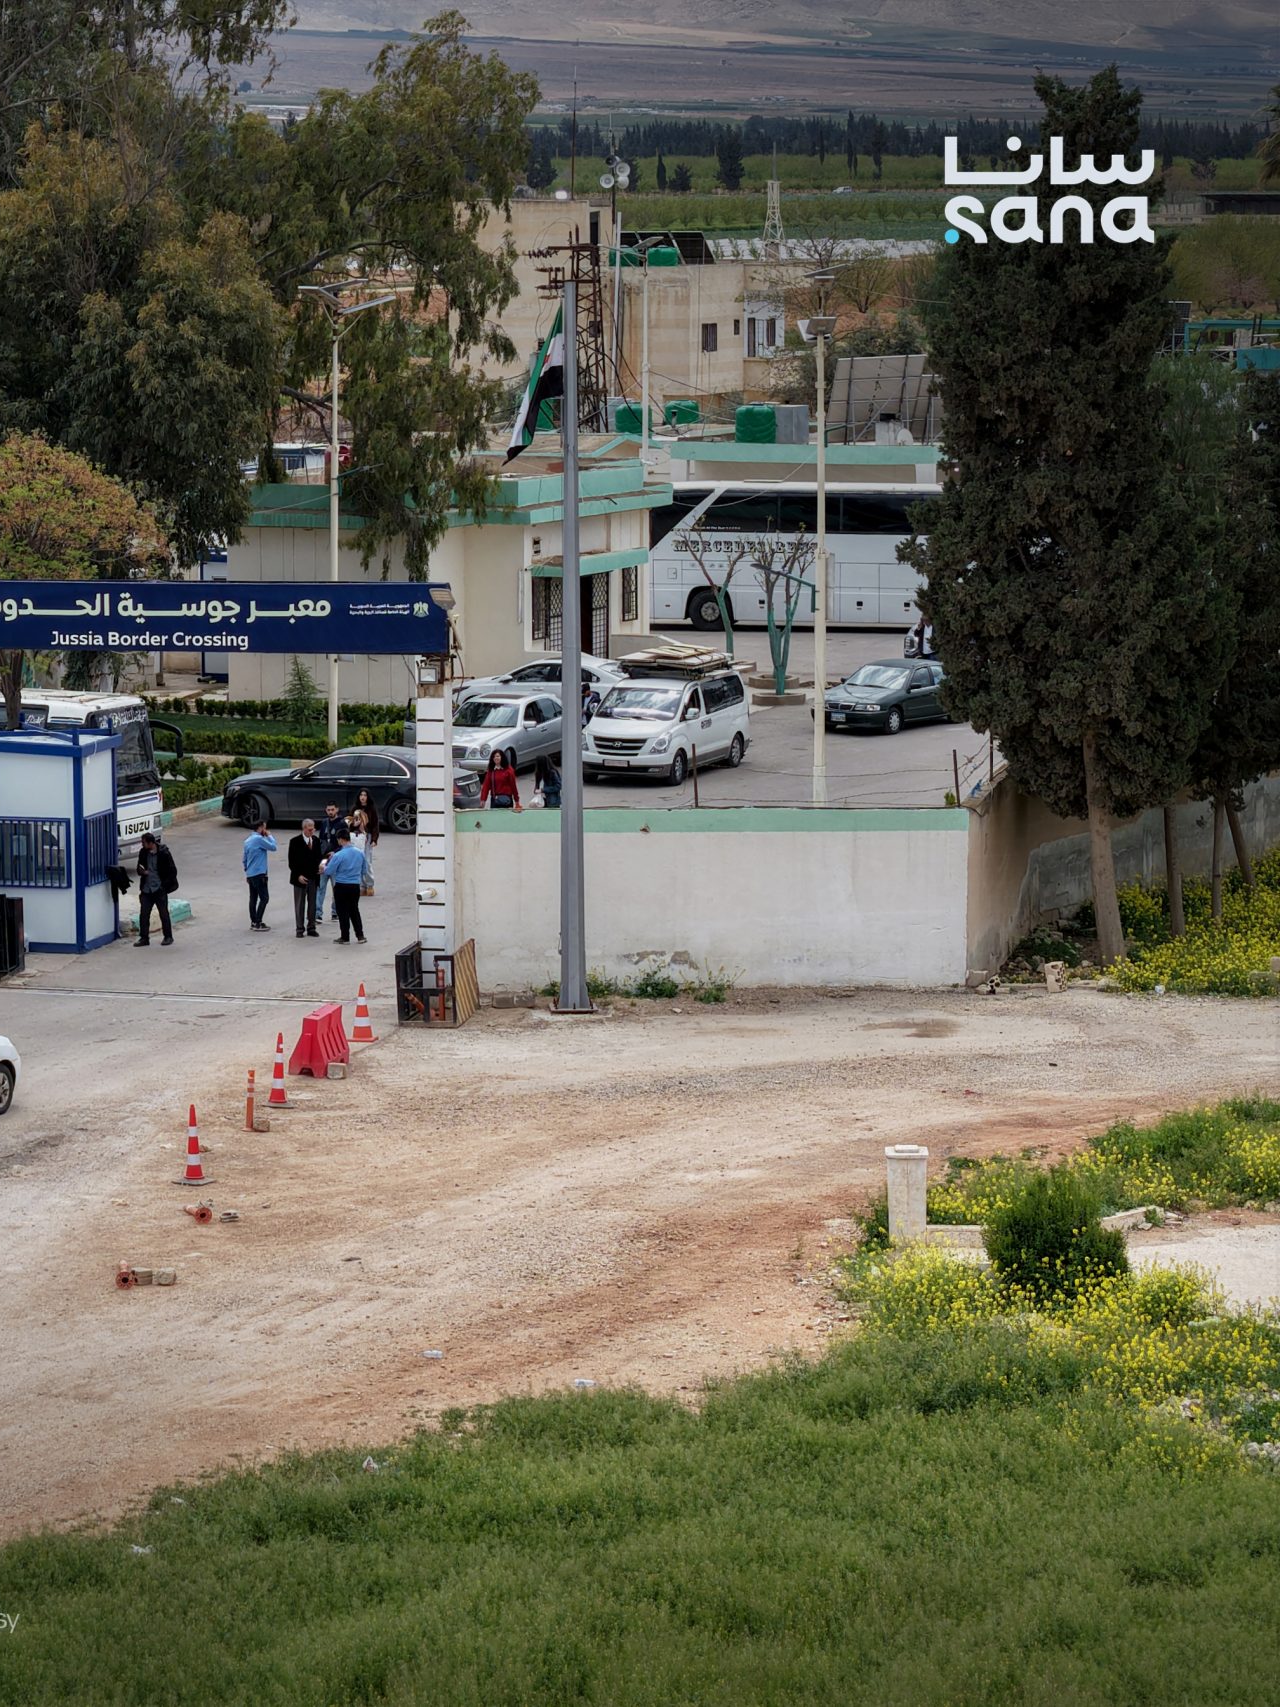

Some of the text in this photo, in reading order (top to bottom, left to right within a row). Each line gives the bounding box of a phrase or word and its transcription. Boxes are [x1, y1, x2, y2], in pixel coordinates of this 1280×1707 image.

[117, 592, 241, 624] جوسية
[246, 599, 332, 624] معبر
[50, 630, 249, 650] Jussia Border Crossing
[125, 820, 150, 836] ISUZU
